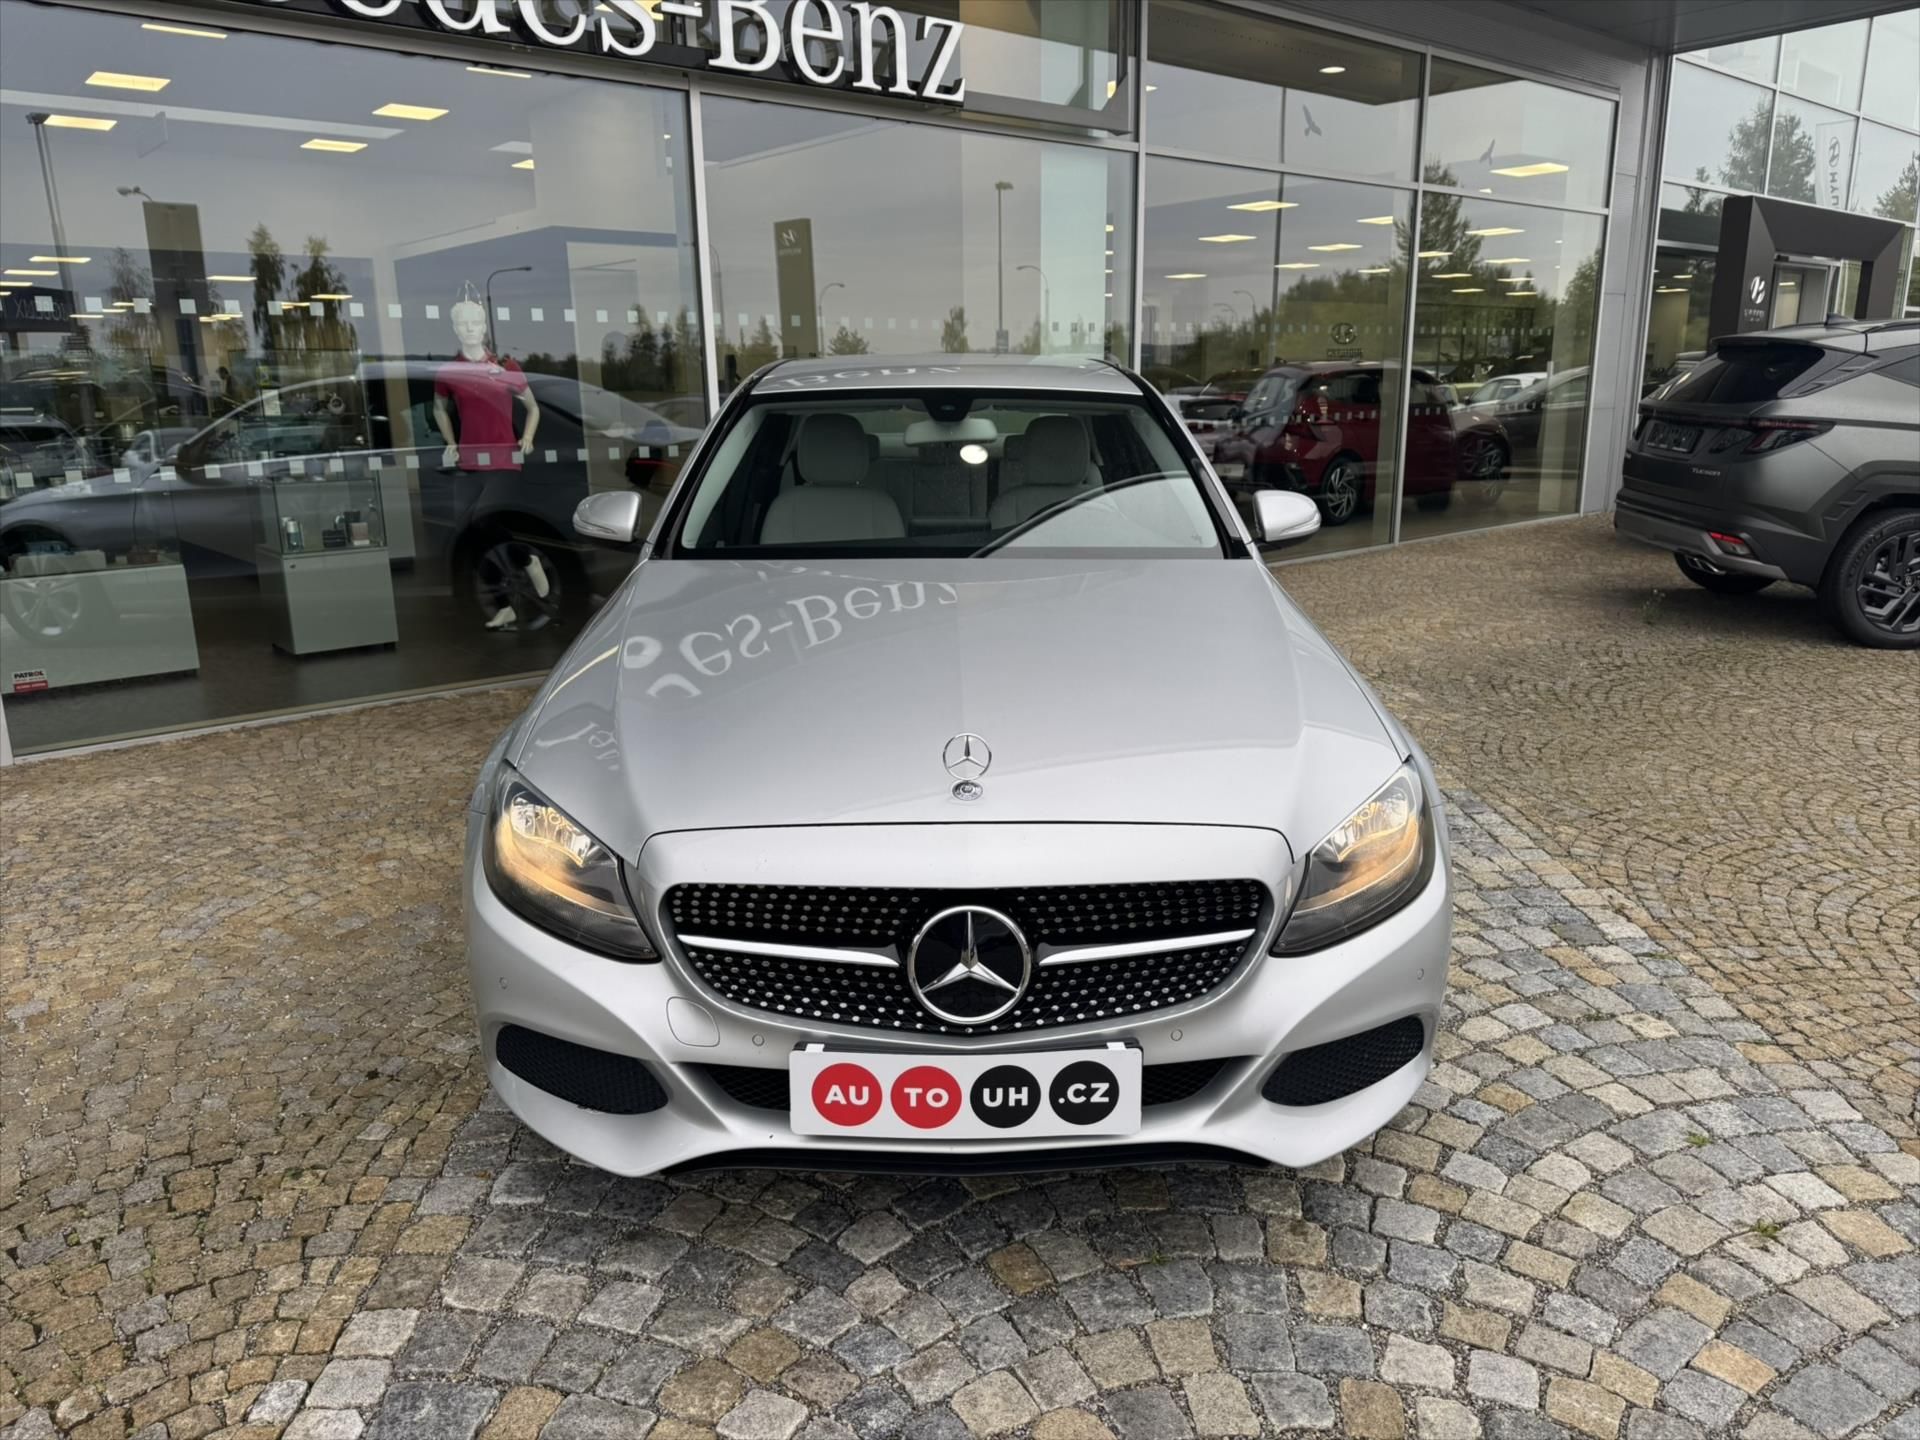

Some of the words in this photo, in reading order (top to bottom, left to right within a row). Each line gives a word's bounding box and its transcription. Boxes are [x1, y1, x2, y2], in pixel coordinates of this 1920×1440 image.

[348, 0, 965, 102] s-Benz
[14, 671, 44, 679] PATROL
[824, 1085, 869, 1106] AU
[904, 1087, 949, 1108] TO
[982, 1086, 1028, 1107] UH
[1058, 1082, 1110, 1104] .CZ
